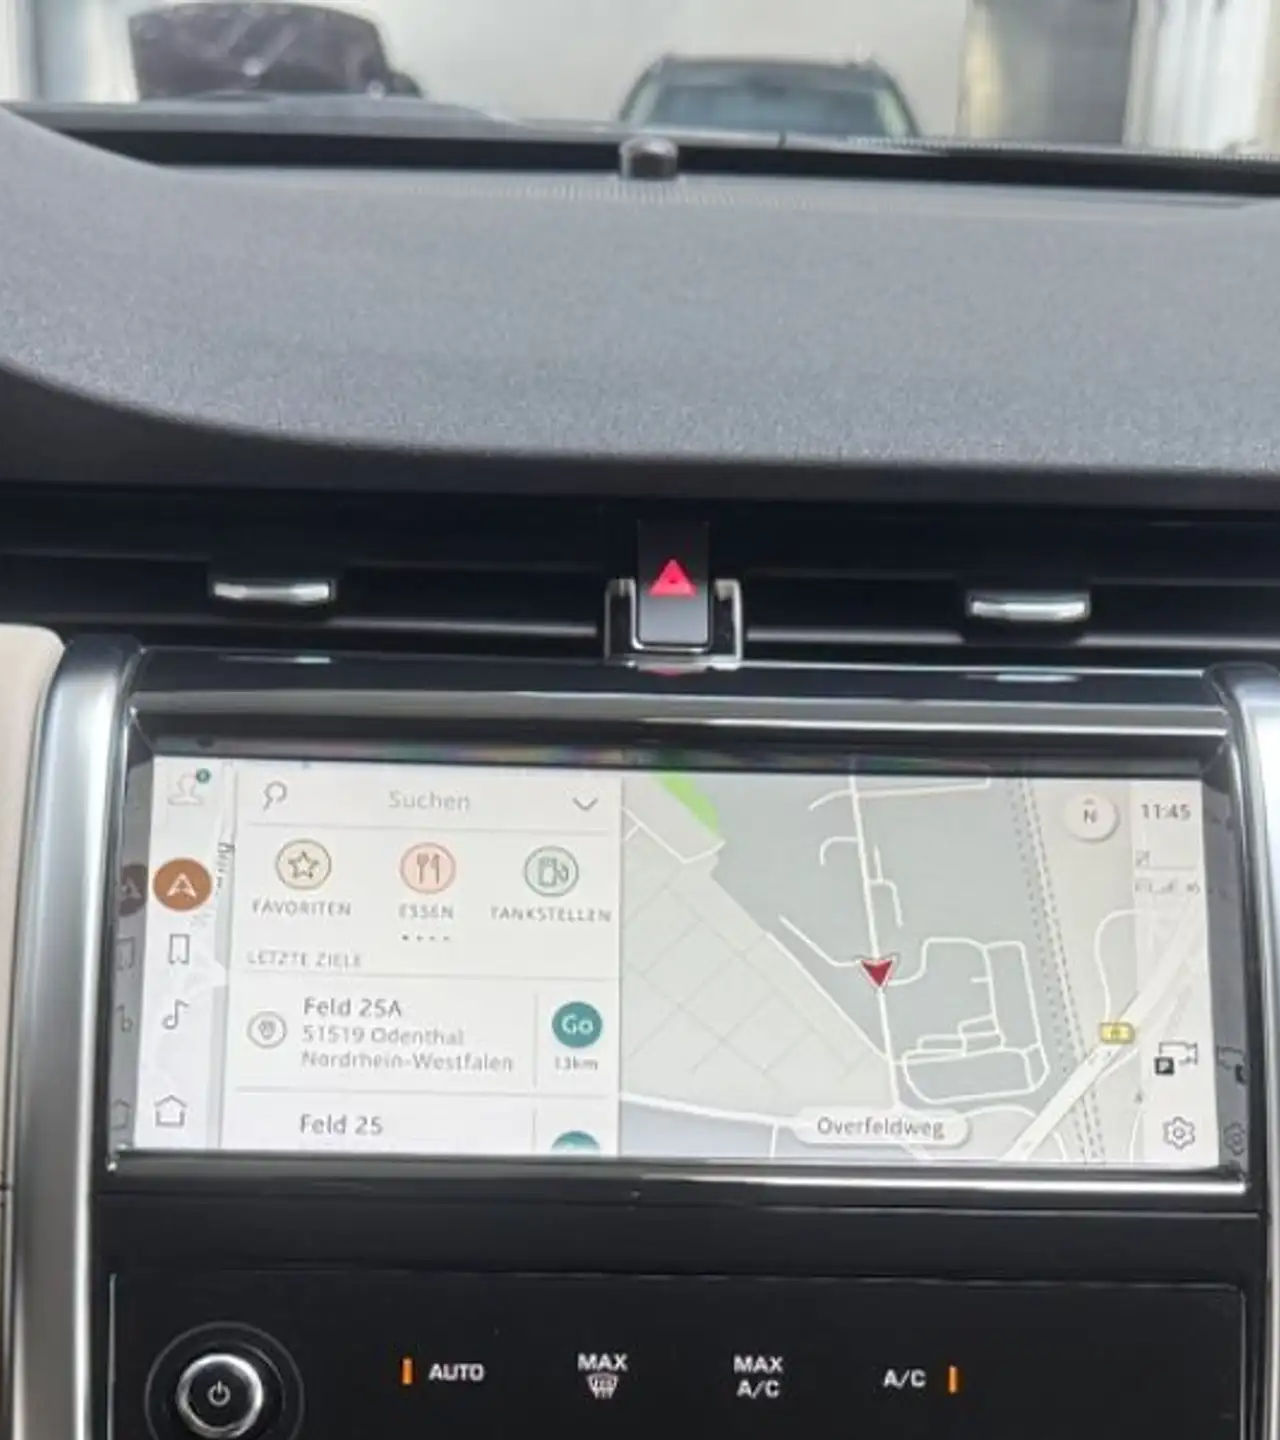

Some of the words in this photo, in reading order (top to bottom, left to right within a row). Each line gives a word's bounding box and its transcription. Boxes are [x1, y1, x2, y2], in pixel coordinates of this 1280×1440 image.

[388, 790, 471, 812] Suchen
[1140, 803, 1192, 822] 11:45
[252, 900, 352, 917] FAVORITEN
[490, 907, 613, 923] TANKSTELLEN
[303, 996, 352, 1018] Feld
[358, 999, 403, 1019] 25A
[562, 1015, 595, 1036] Go
[303, 1026, 366, 1044] 51519
[370, 1028, 464, 1046] Odenthal
[301, 1051, 514, 1074] Nordrhein-Westfalen
[300, 1114, 348, 1136] Feld
[356, 1116, 384, 1136] 25
[817, 1116, 945, 1140] Overfeldweg
[429, 1362, 485, 1382] AUTO
[578, 1353, 628, 1372] MAX
[733, 1355, 784, 1373] MAX
[882, 1369, 926, 1388] A/C
[737, 1381, 780, 1397] A/C
